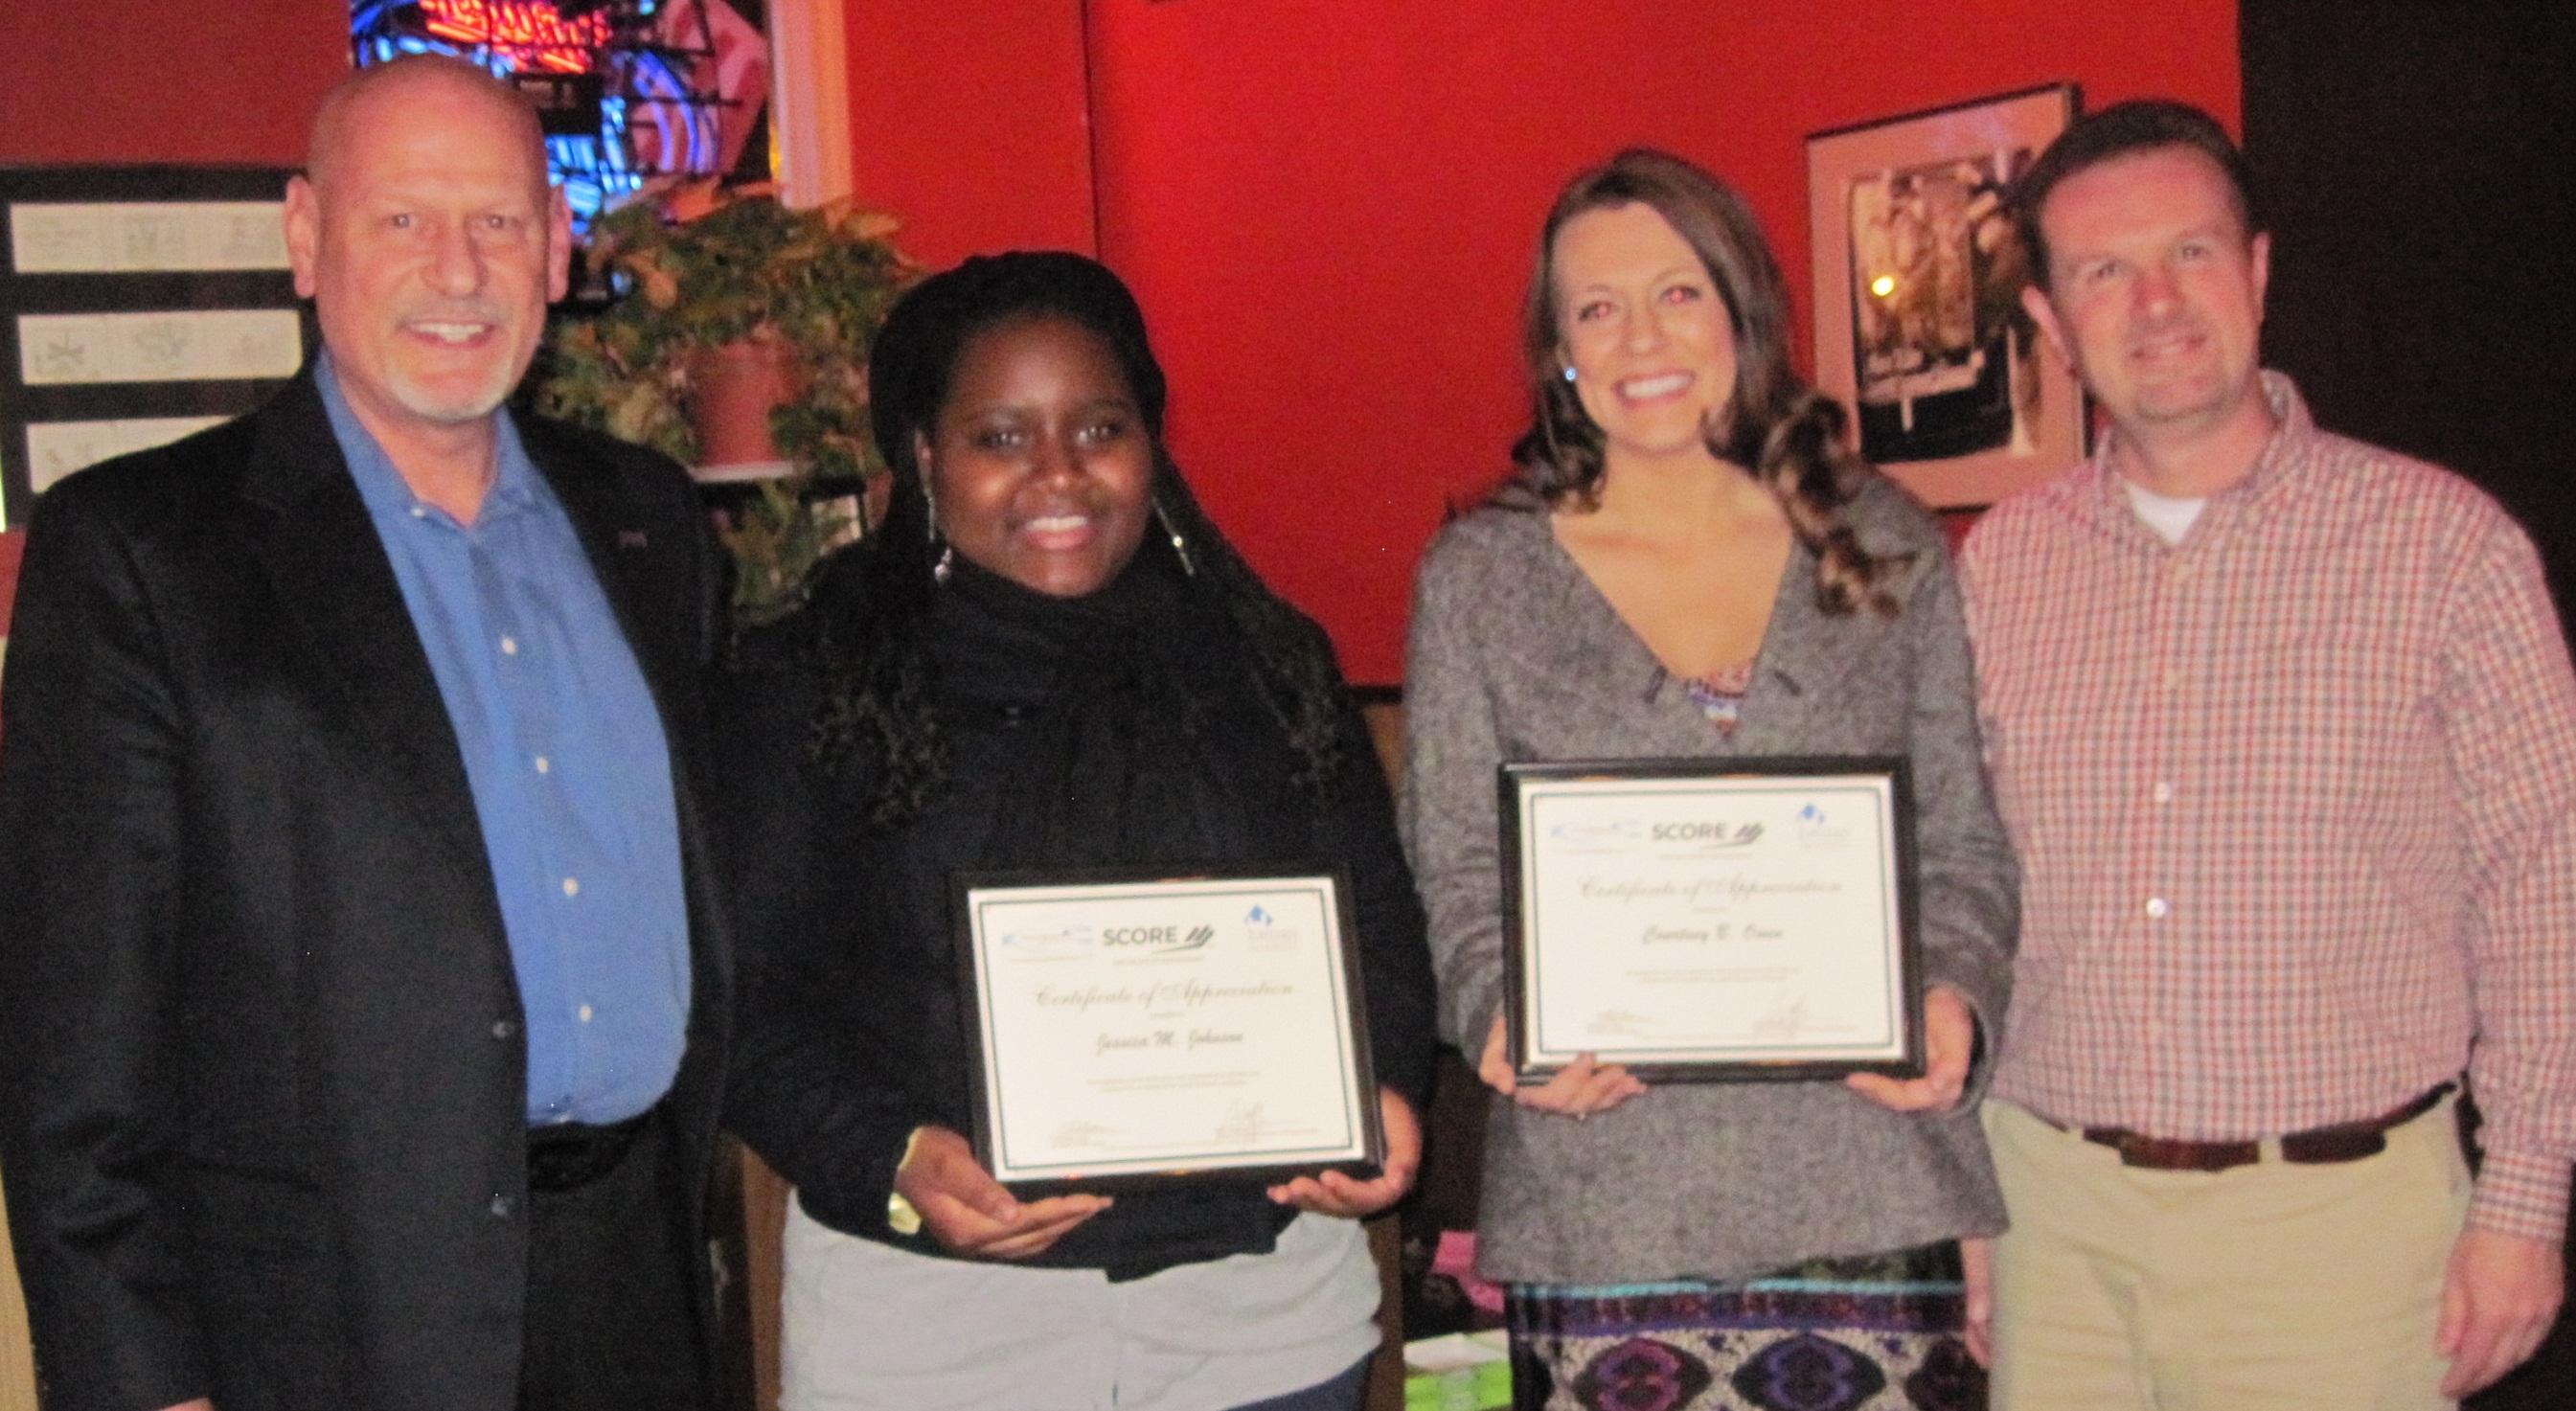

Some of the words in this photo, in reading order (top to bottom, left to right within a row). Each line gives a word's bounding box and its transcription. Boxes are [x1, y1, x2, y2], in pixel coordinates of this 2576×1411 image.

[1653, 821, 1726, 842] SCORE
[1578, 875, 1676, 902] Certificate
[1682, 877, 1704, 902] of
[1103, 925, 1178, 946] SCORE
[1035, 983, 1132, 1012] Certificate
[1137, 981, 1161, 1009] of
[1160, 977, 1293, 1007] Appreciation
